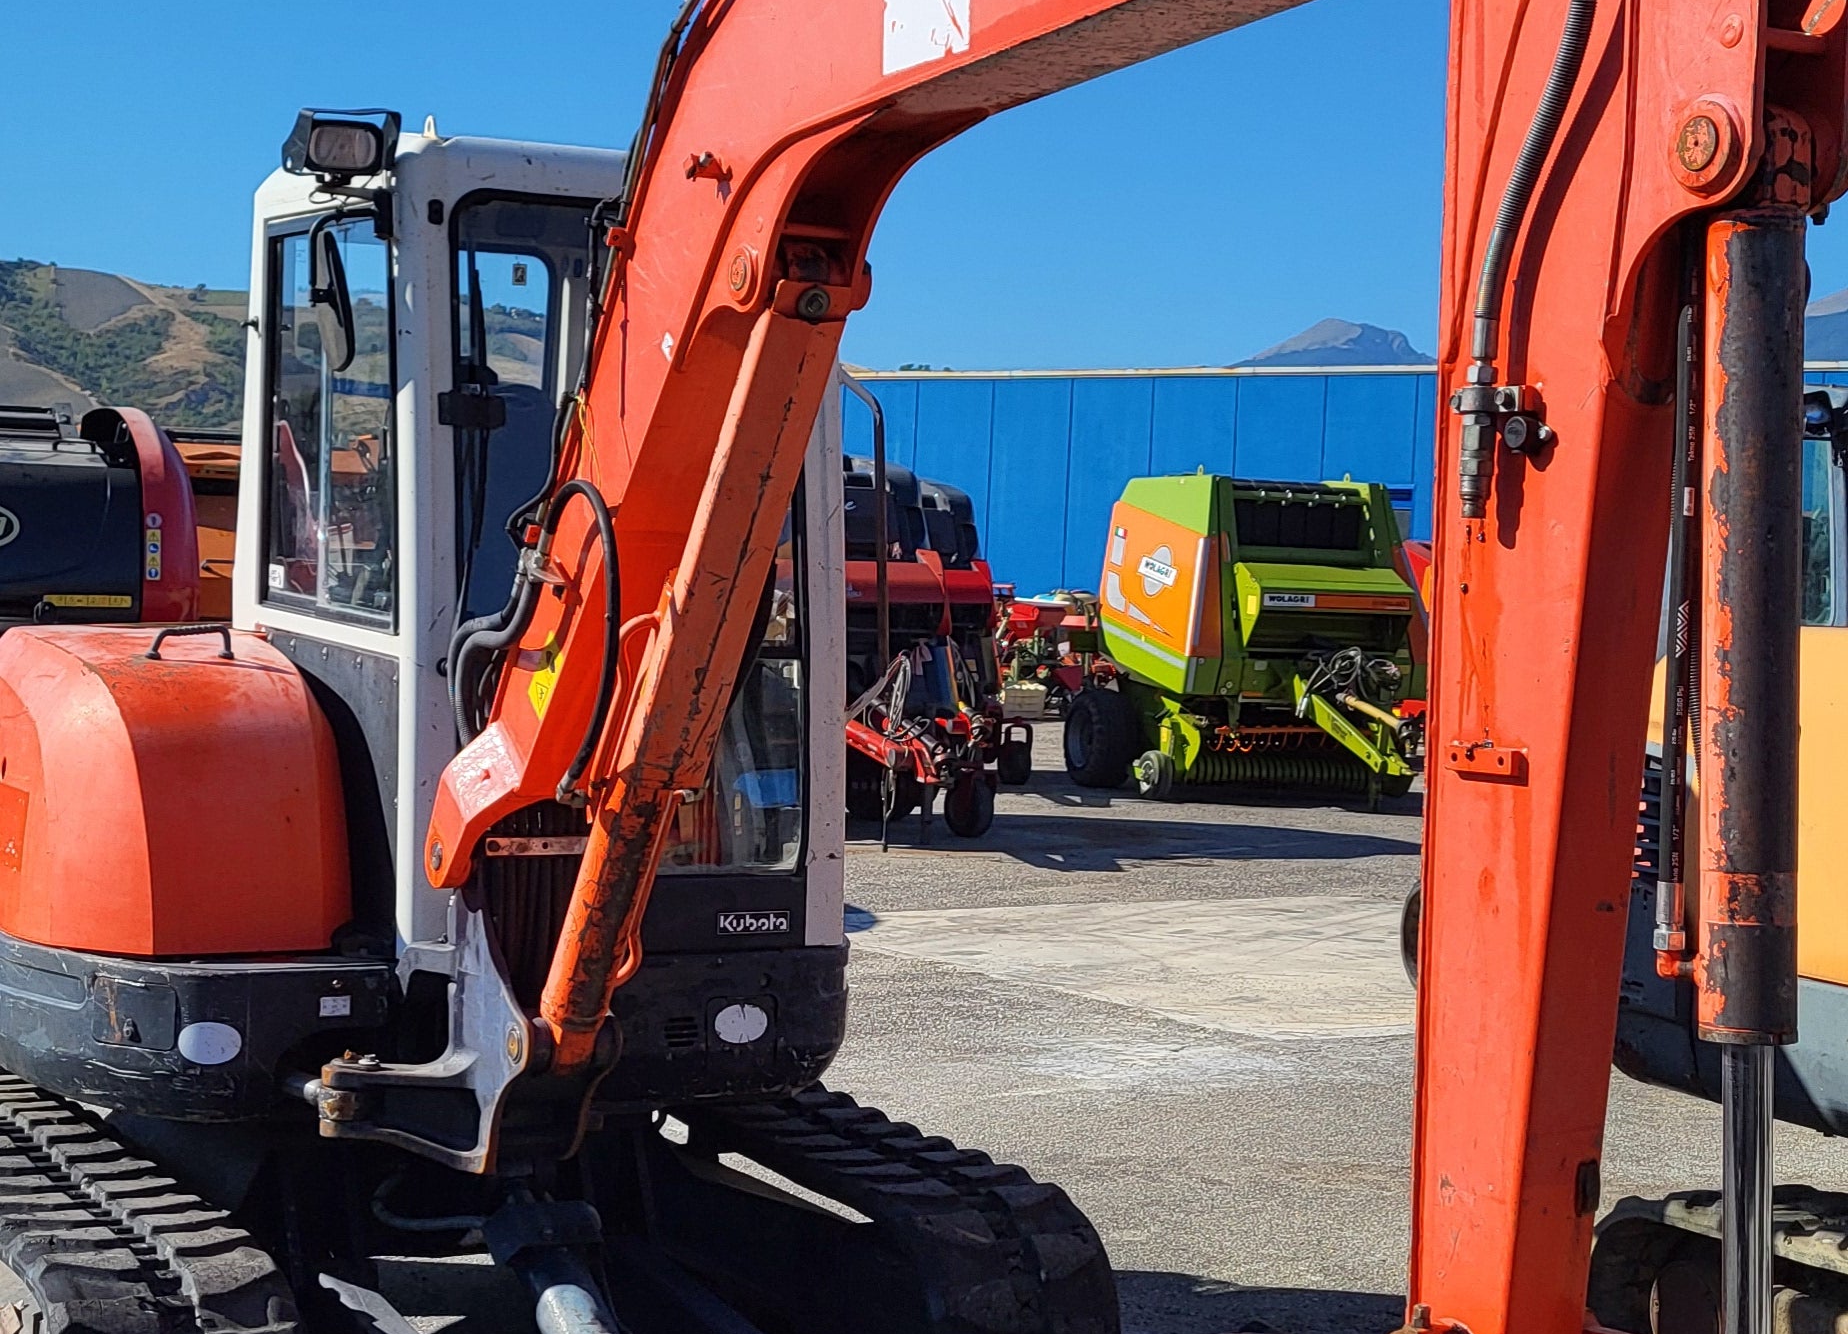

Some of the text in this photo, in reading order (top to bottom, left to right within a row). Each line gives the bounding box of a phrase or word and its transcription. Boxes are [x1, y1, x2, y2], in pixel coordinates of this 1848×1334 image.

[1144, 559, 1173, 579] WOLAGRI
[1268, 595, 1309, 604] WOLAGRI
[720, 913, 787, 932] Kubota
